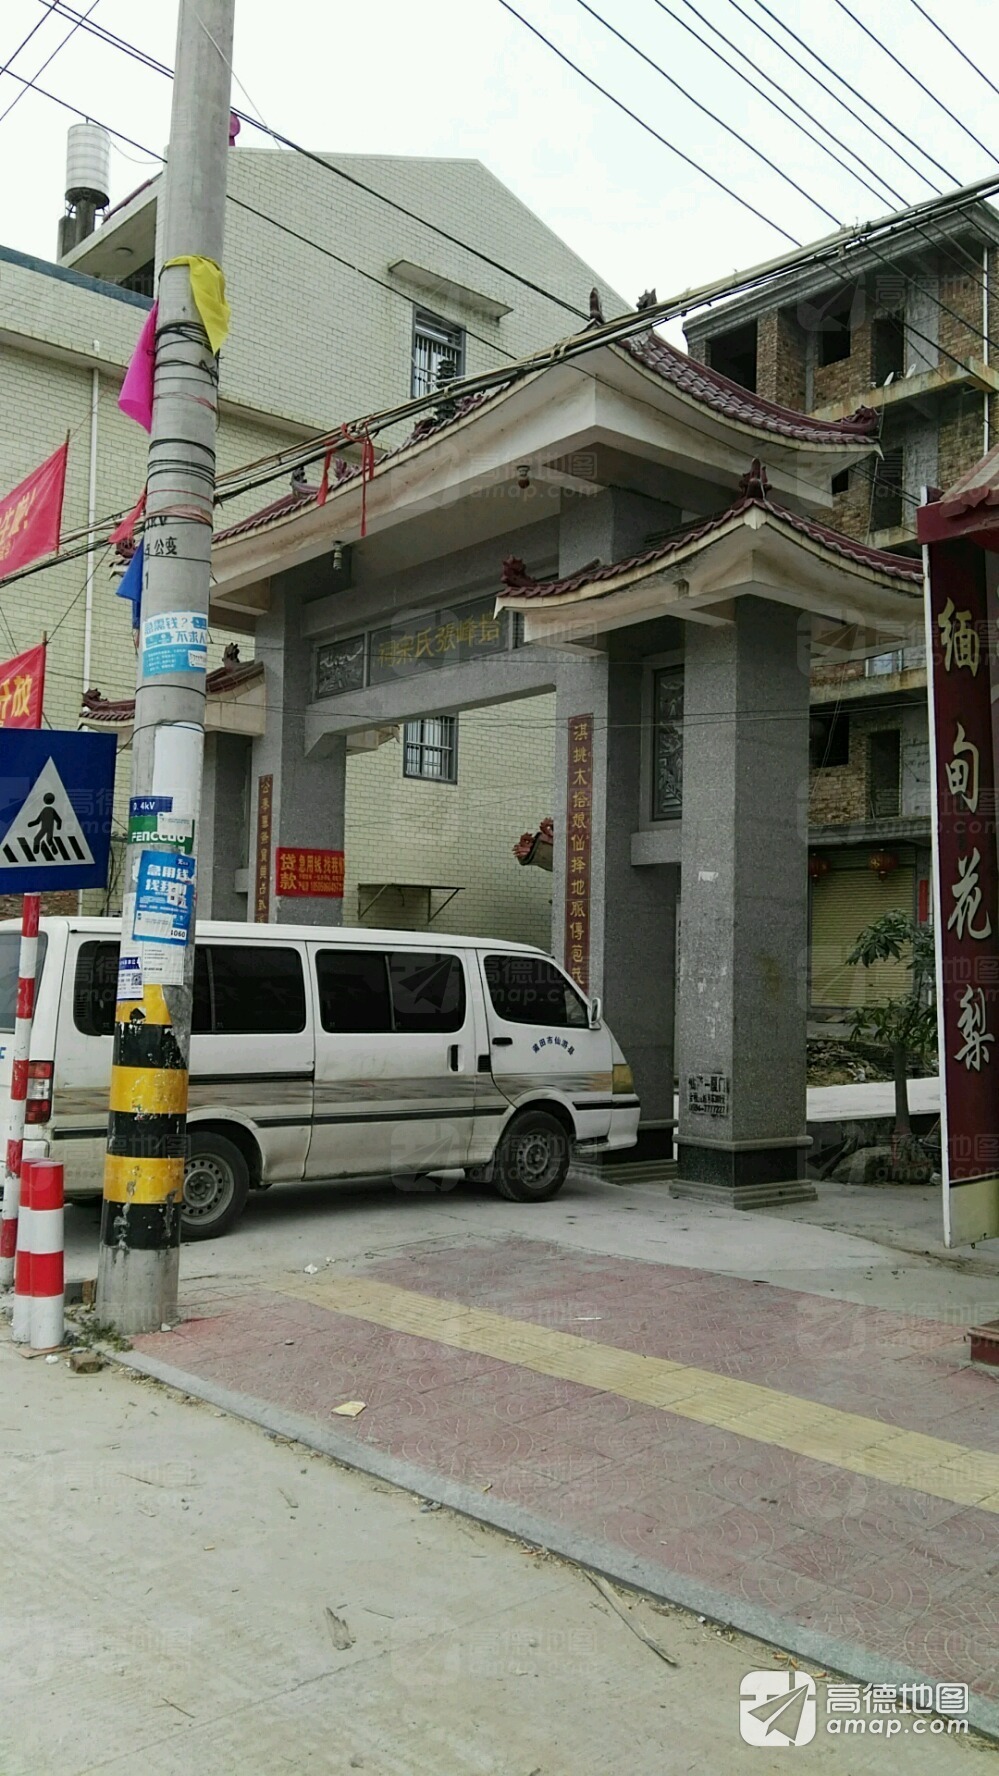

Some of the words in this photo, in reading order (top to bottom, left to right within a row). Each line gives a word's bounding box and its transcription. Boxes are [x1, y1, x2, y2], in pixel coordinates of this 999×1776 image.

[937, 596, 996, 1073] 缅甸花梨
[280, 854, 297, 890] 贷款
[532, 1035, 575, 1056] 莆田市仙游县
